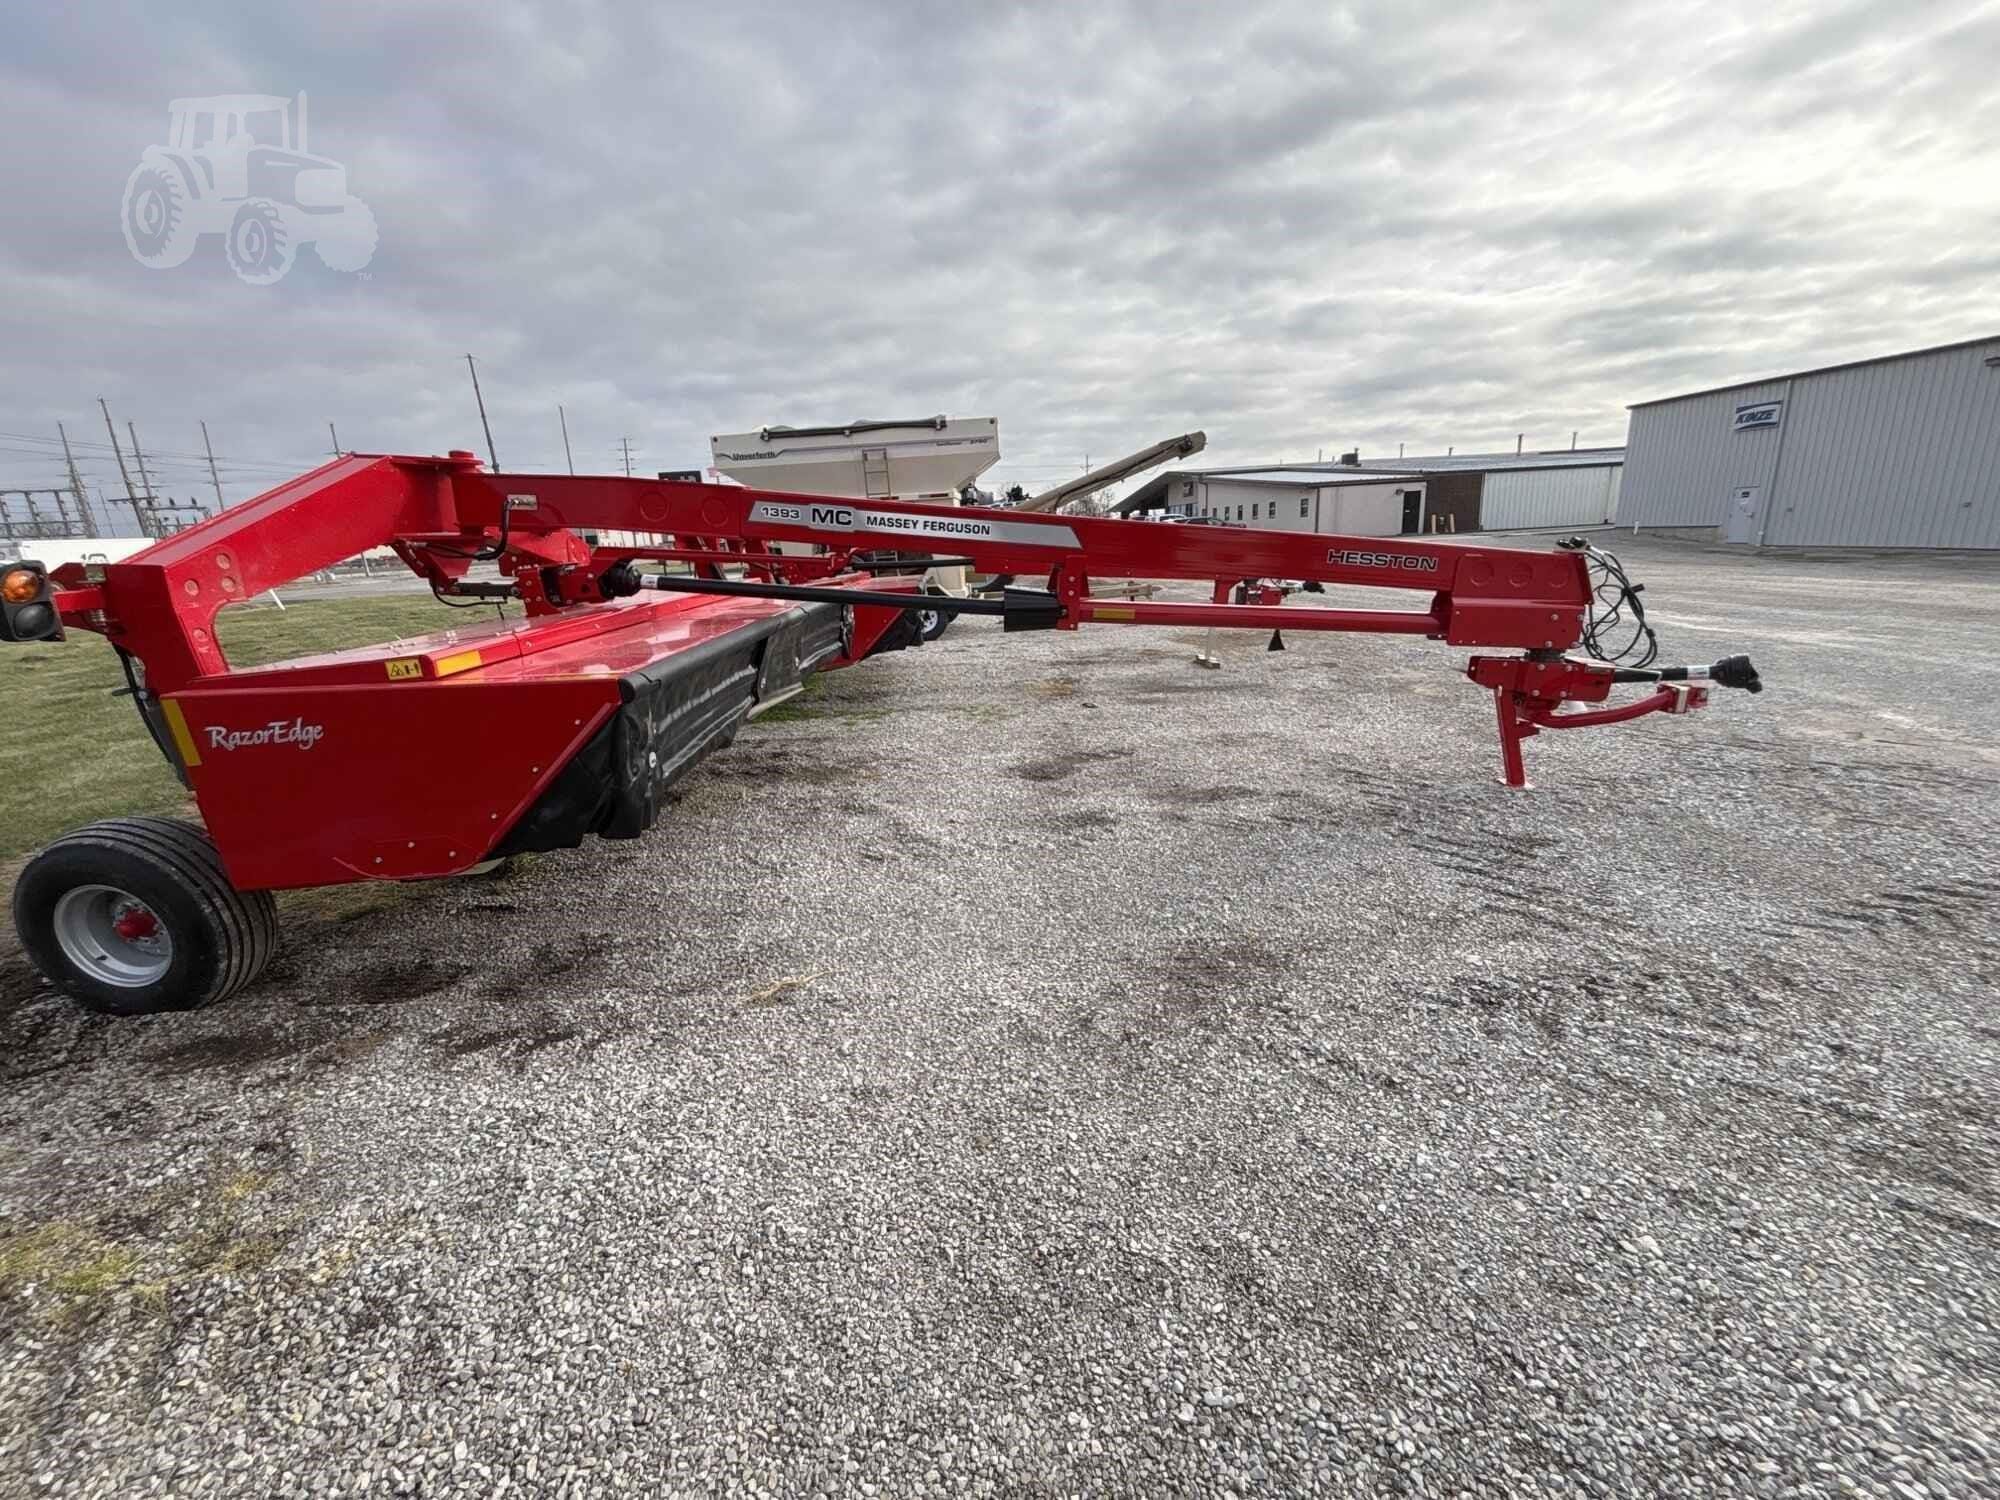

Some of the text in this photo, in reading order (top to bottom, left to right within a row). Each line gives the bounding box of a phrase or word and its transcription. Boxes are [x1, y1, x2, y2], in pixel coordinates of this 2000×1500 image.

[761, 506, 991, 536] 1393 MC MASSEY FERGUSON
[1327, 549, 1439, 571] HESSTON
[203, 716, 324, 751] RazorEdge
